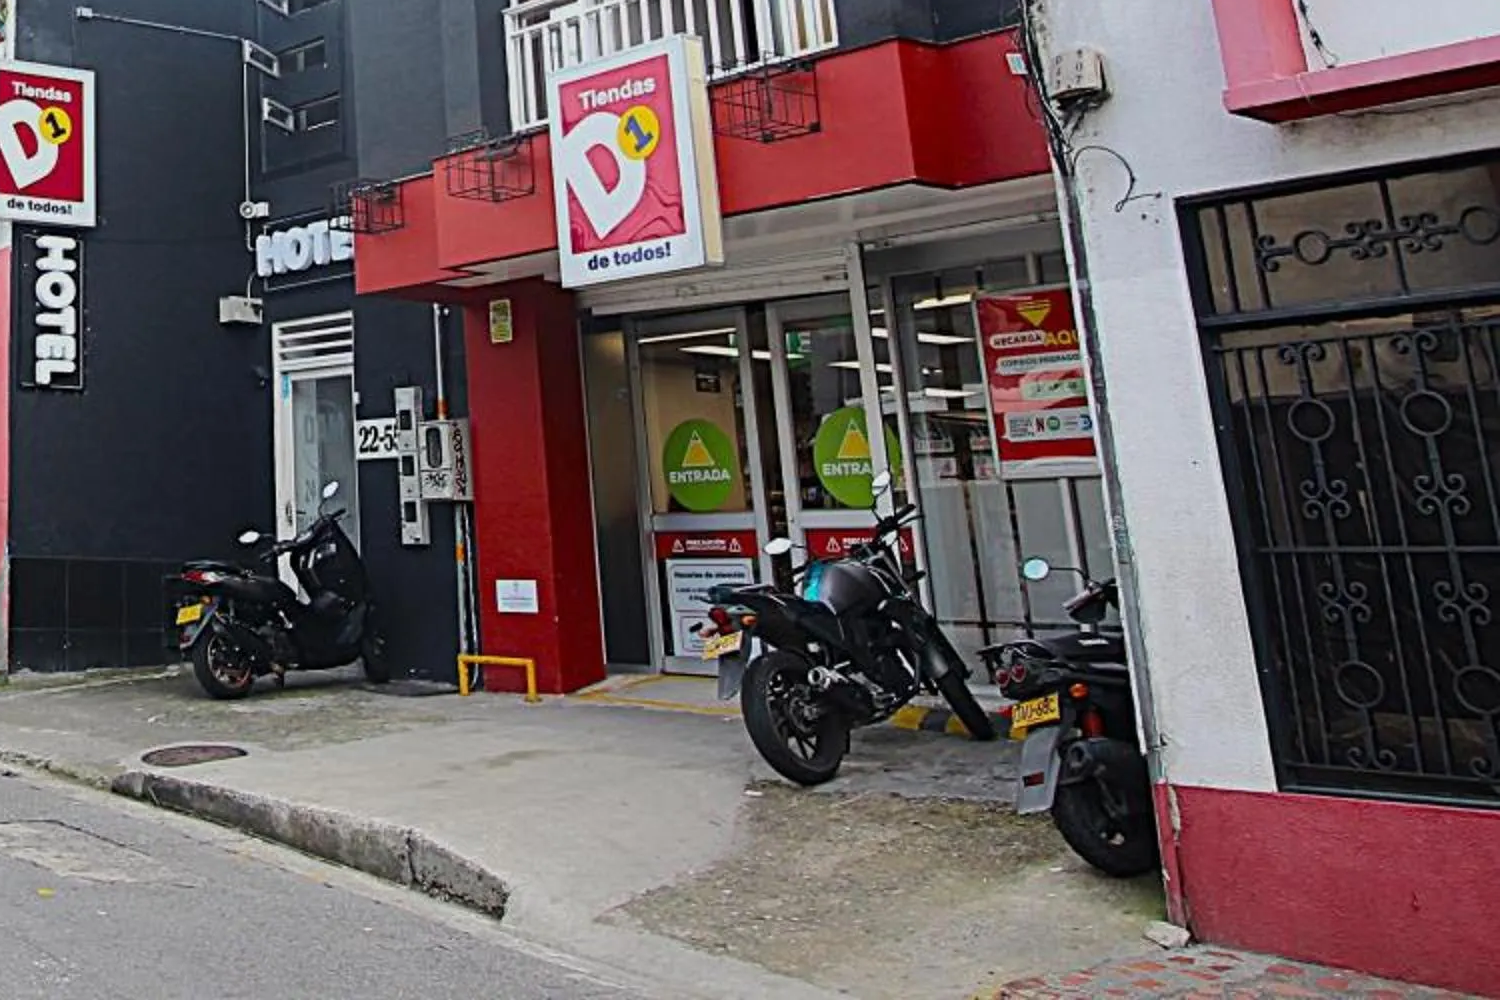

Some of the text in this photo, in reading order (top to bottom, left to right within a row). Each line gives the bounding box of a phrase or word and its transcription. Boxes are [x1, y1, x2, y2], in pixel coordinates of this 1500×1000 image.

[11, 81, 72, 103] Tiendas
[579, 76, 656, 110] Tiendas
[7, 198, 72, 215] de todos!
[256, 216, 355, 277] HOTE
[588, 242, 672, 271] de todos!
[35, 235, 77, 385] HOTEL
[669, 468, 731, 484] ENTRADA
[823, 461, 873, 477] ENTRA
